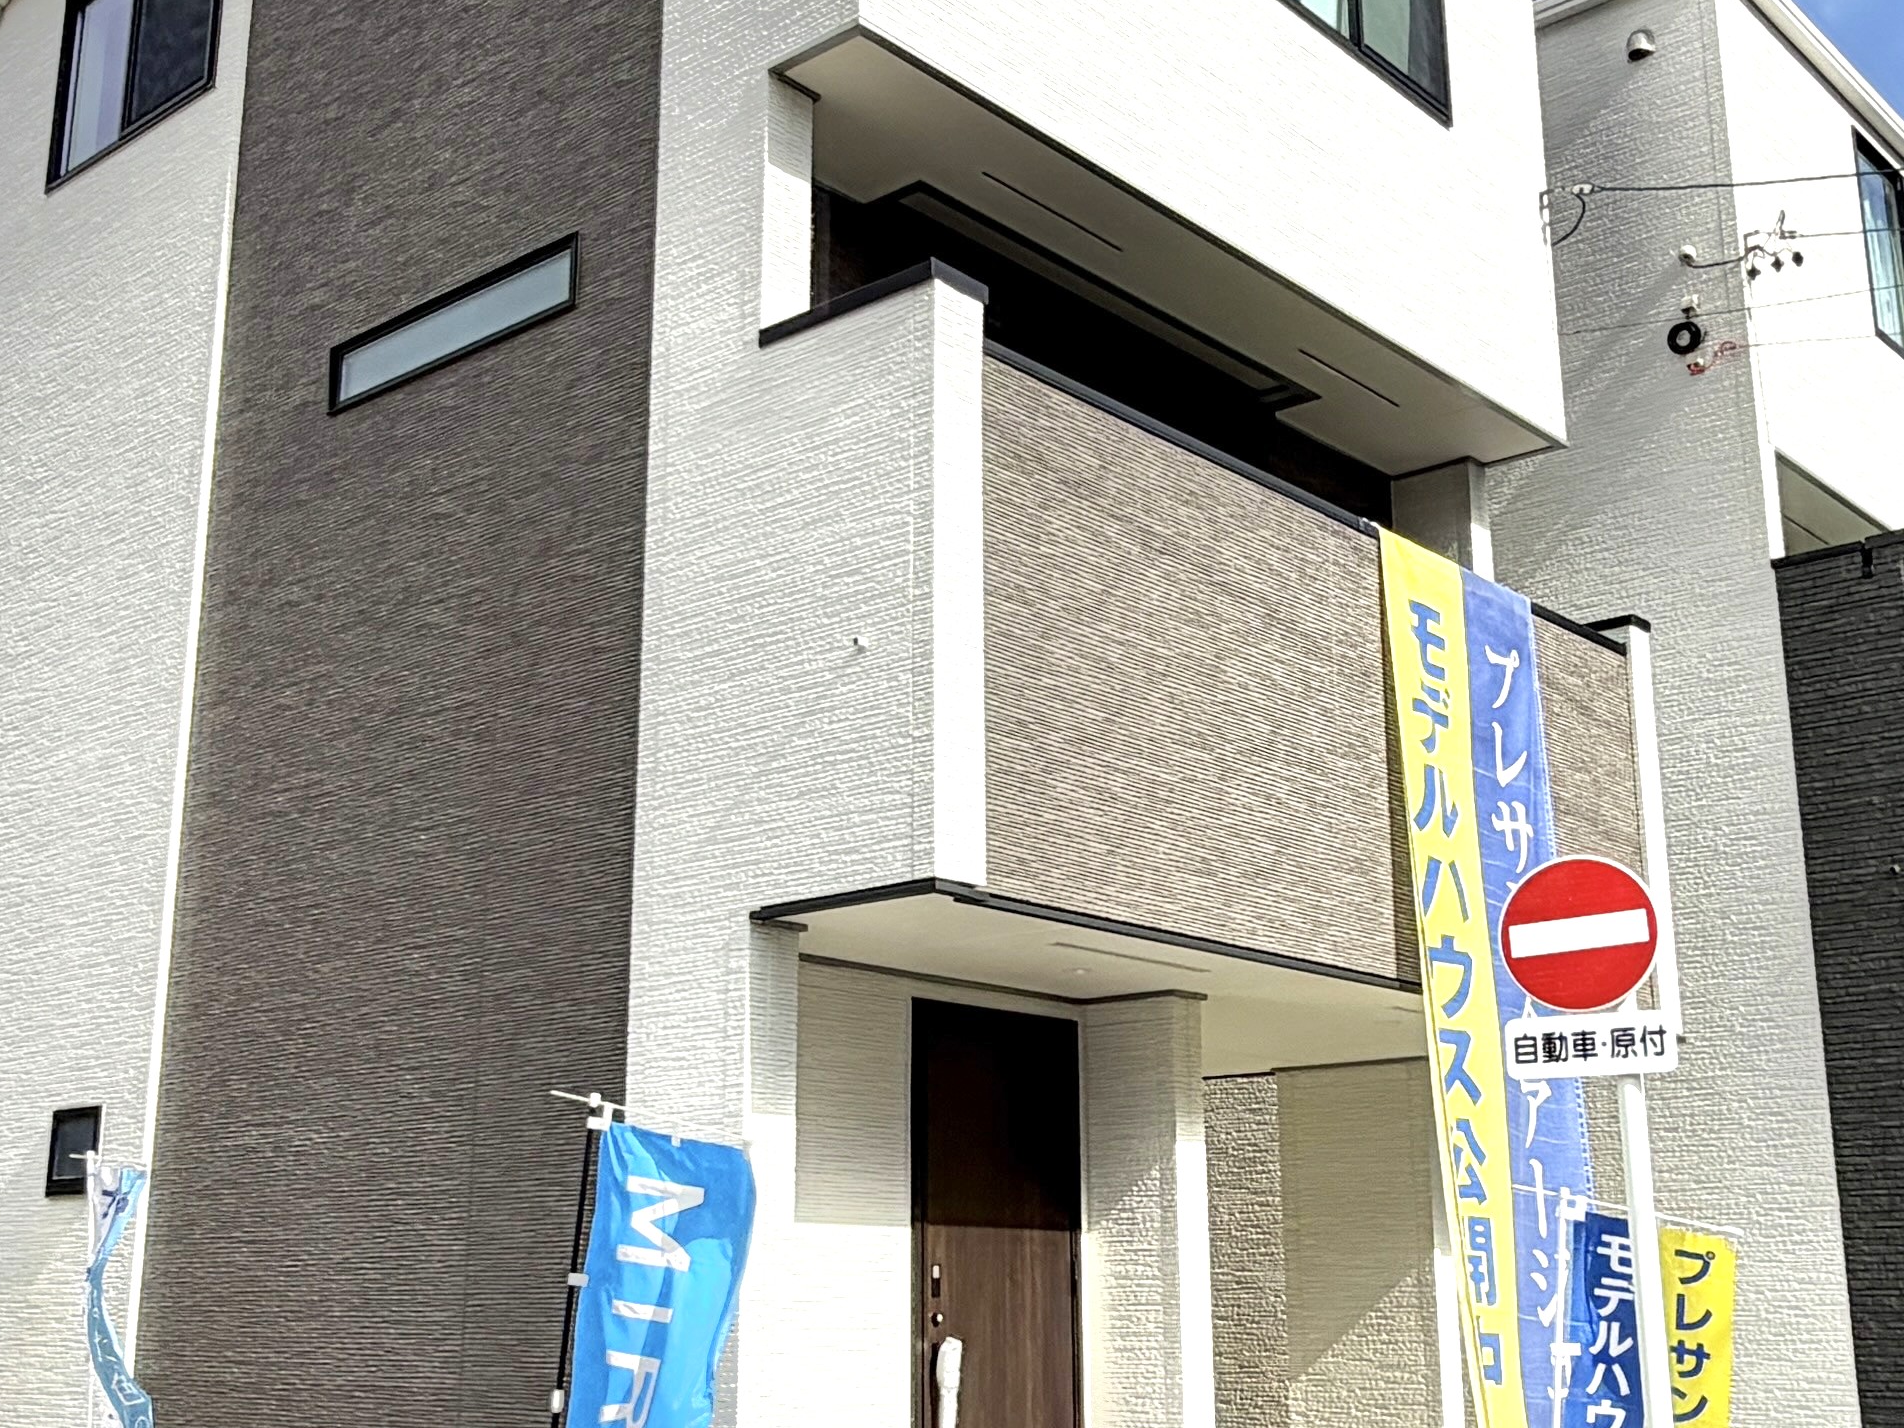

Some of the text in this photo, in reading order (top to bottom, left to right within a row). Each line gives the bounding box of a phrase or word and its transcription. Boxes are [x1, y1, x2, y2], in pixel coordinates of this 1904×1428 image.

[1512, 1023, 1668, 1065] 自動車・原付
